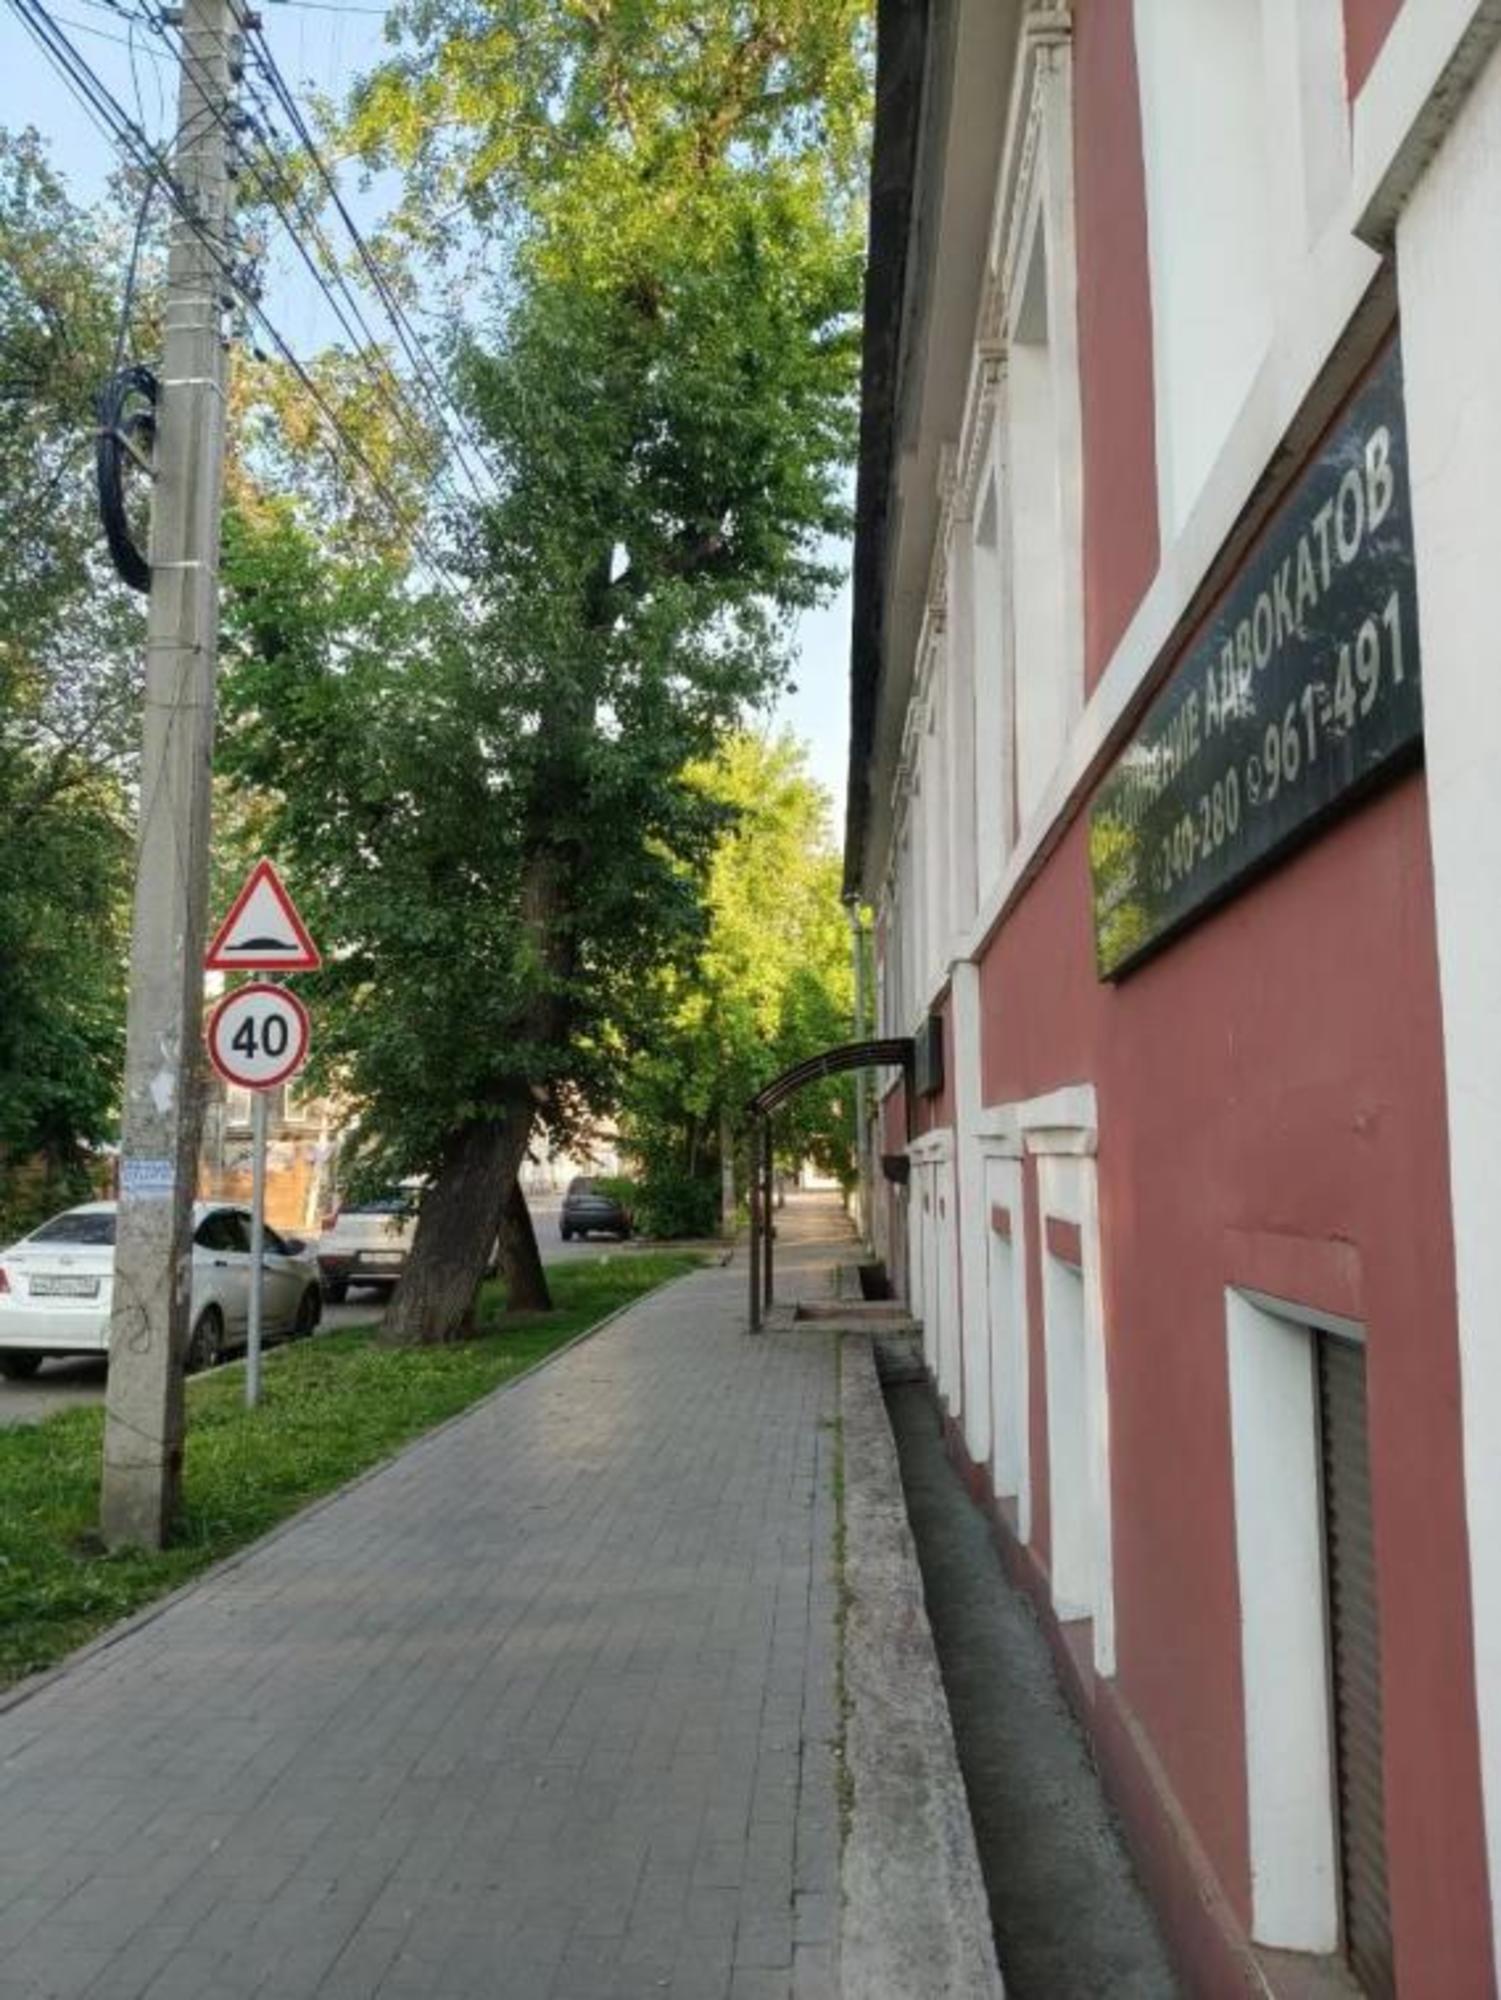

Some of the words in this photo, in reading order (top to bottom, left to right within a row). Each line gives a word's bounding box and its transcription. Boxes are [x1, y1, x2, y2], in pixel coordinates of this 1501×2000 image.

[1204, 425, 1394, 738] АДВОКАТОВ
[1263, 589, 1404, 800] 961-491
[231, 1013, 289, 1060] 40
